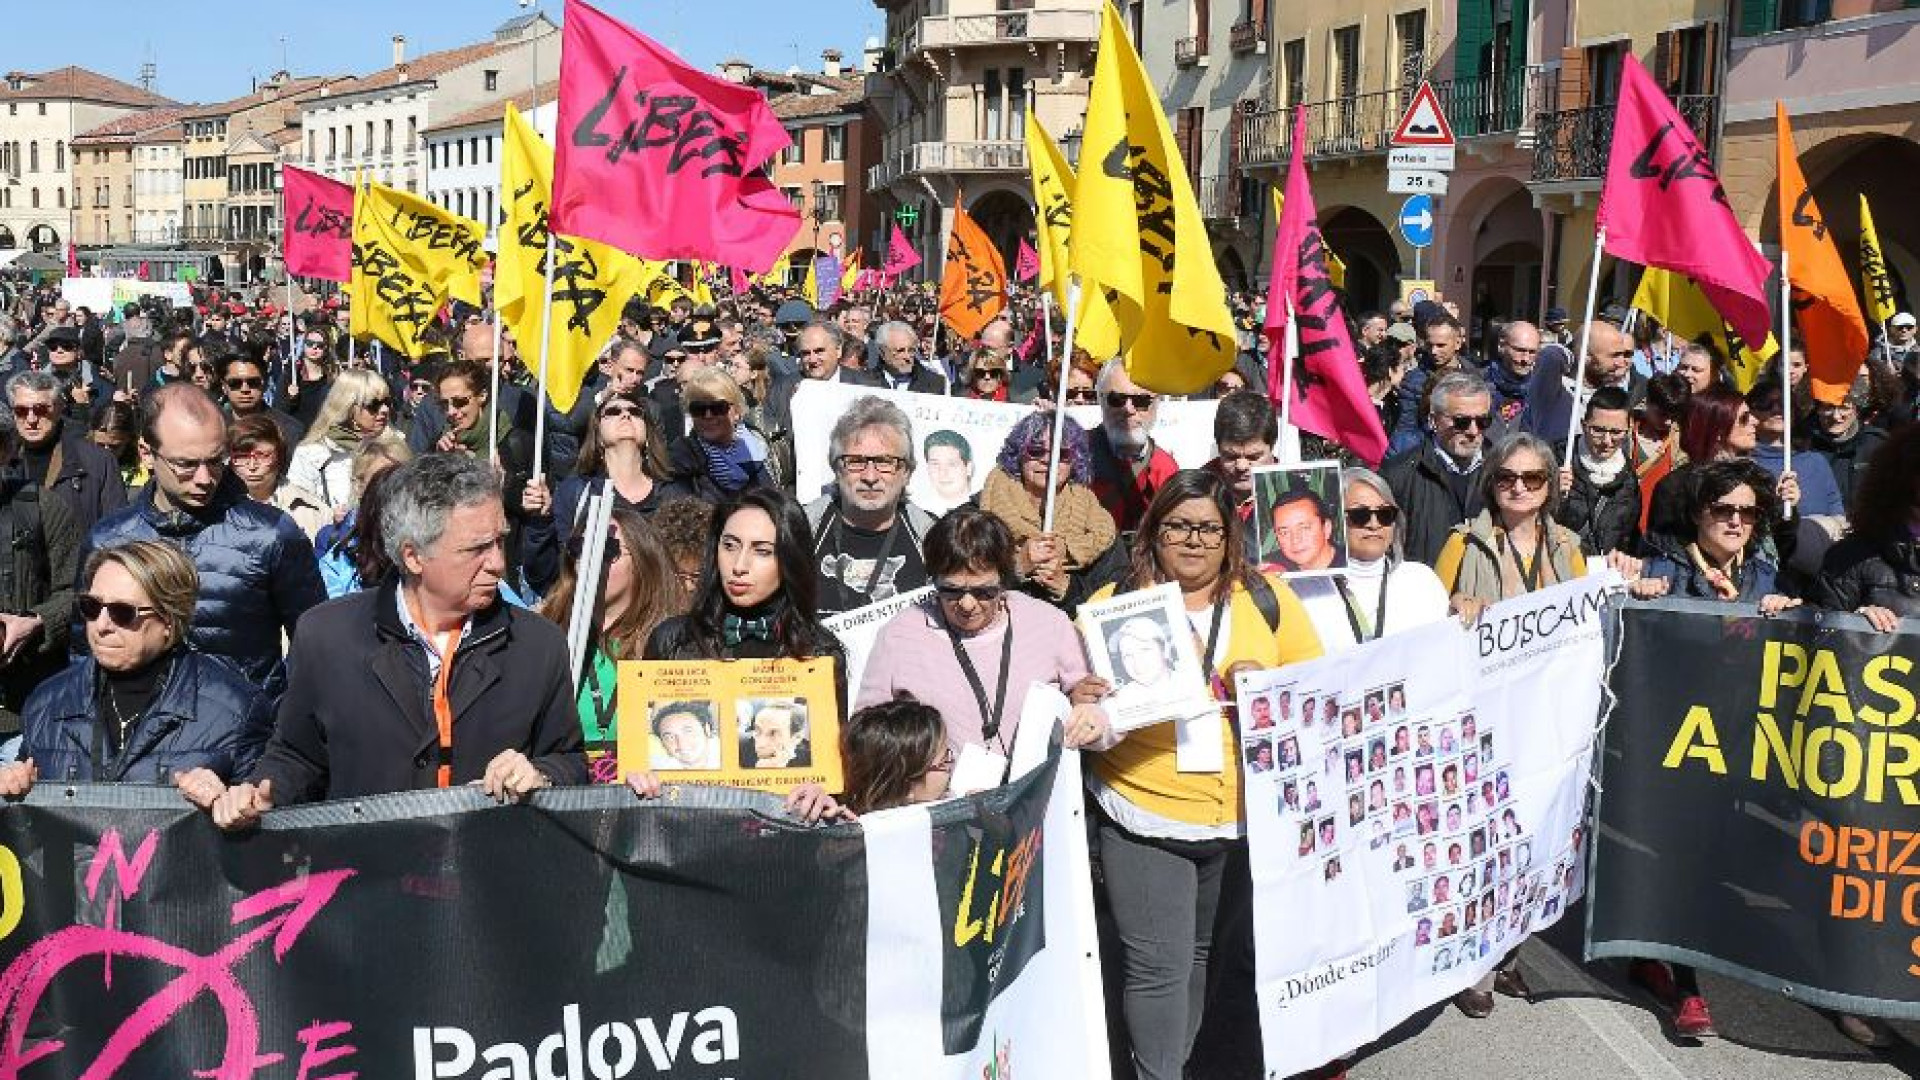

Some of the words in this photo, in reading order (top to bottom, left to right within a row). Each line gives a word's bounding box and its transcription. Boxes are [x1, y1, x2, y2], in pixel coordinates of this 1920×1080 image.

[1406, 176, 1423, 187] 25
[1759, 639, 1920, 727] PAS
[1662, 705, 1728, 775] A
[1750, 711, 1920, 806] NOR
[1800, 820, 1920, 875] ORIZ
[1831, 873, 1886, 922] DI
[412, 1003, 740, 1080] Padova
